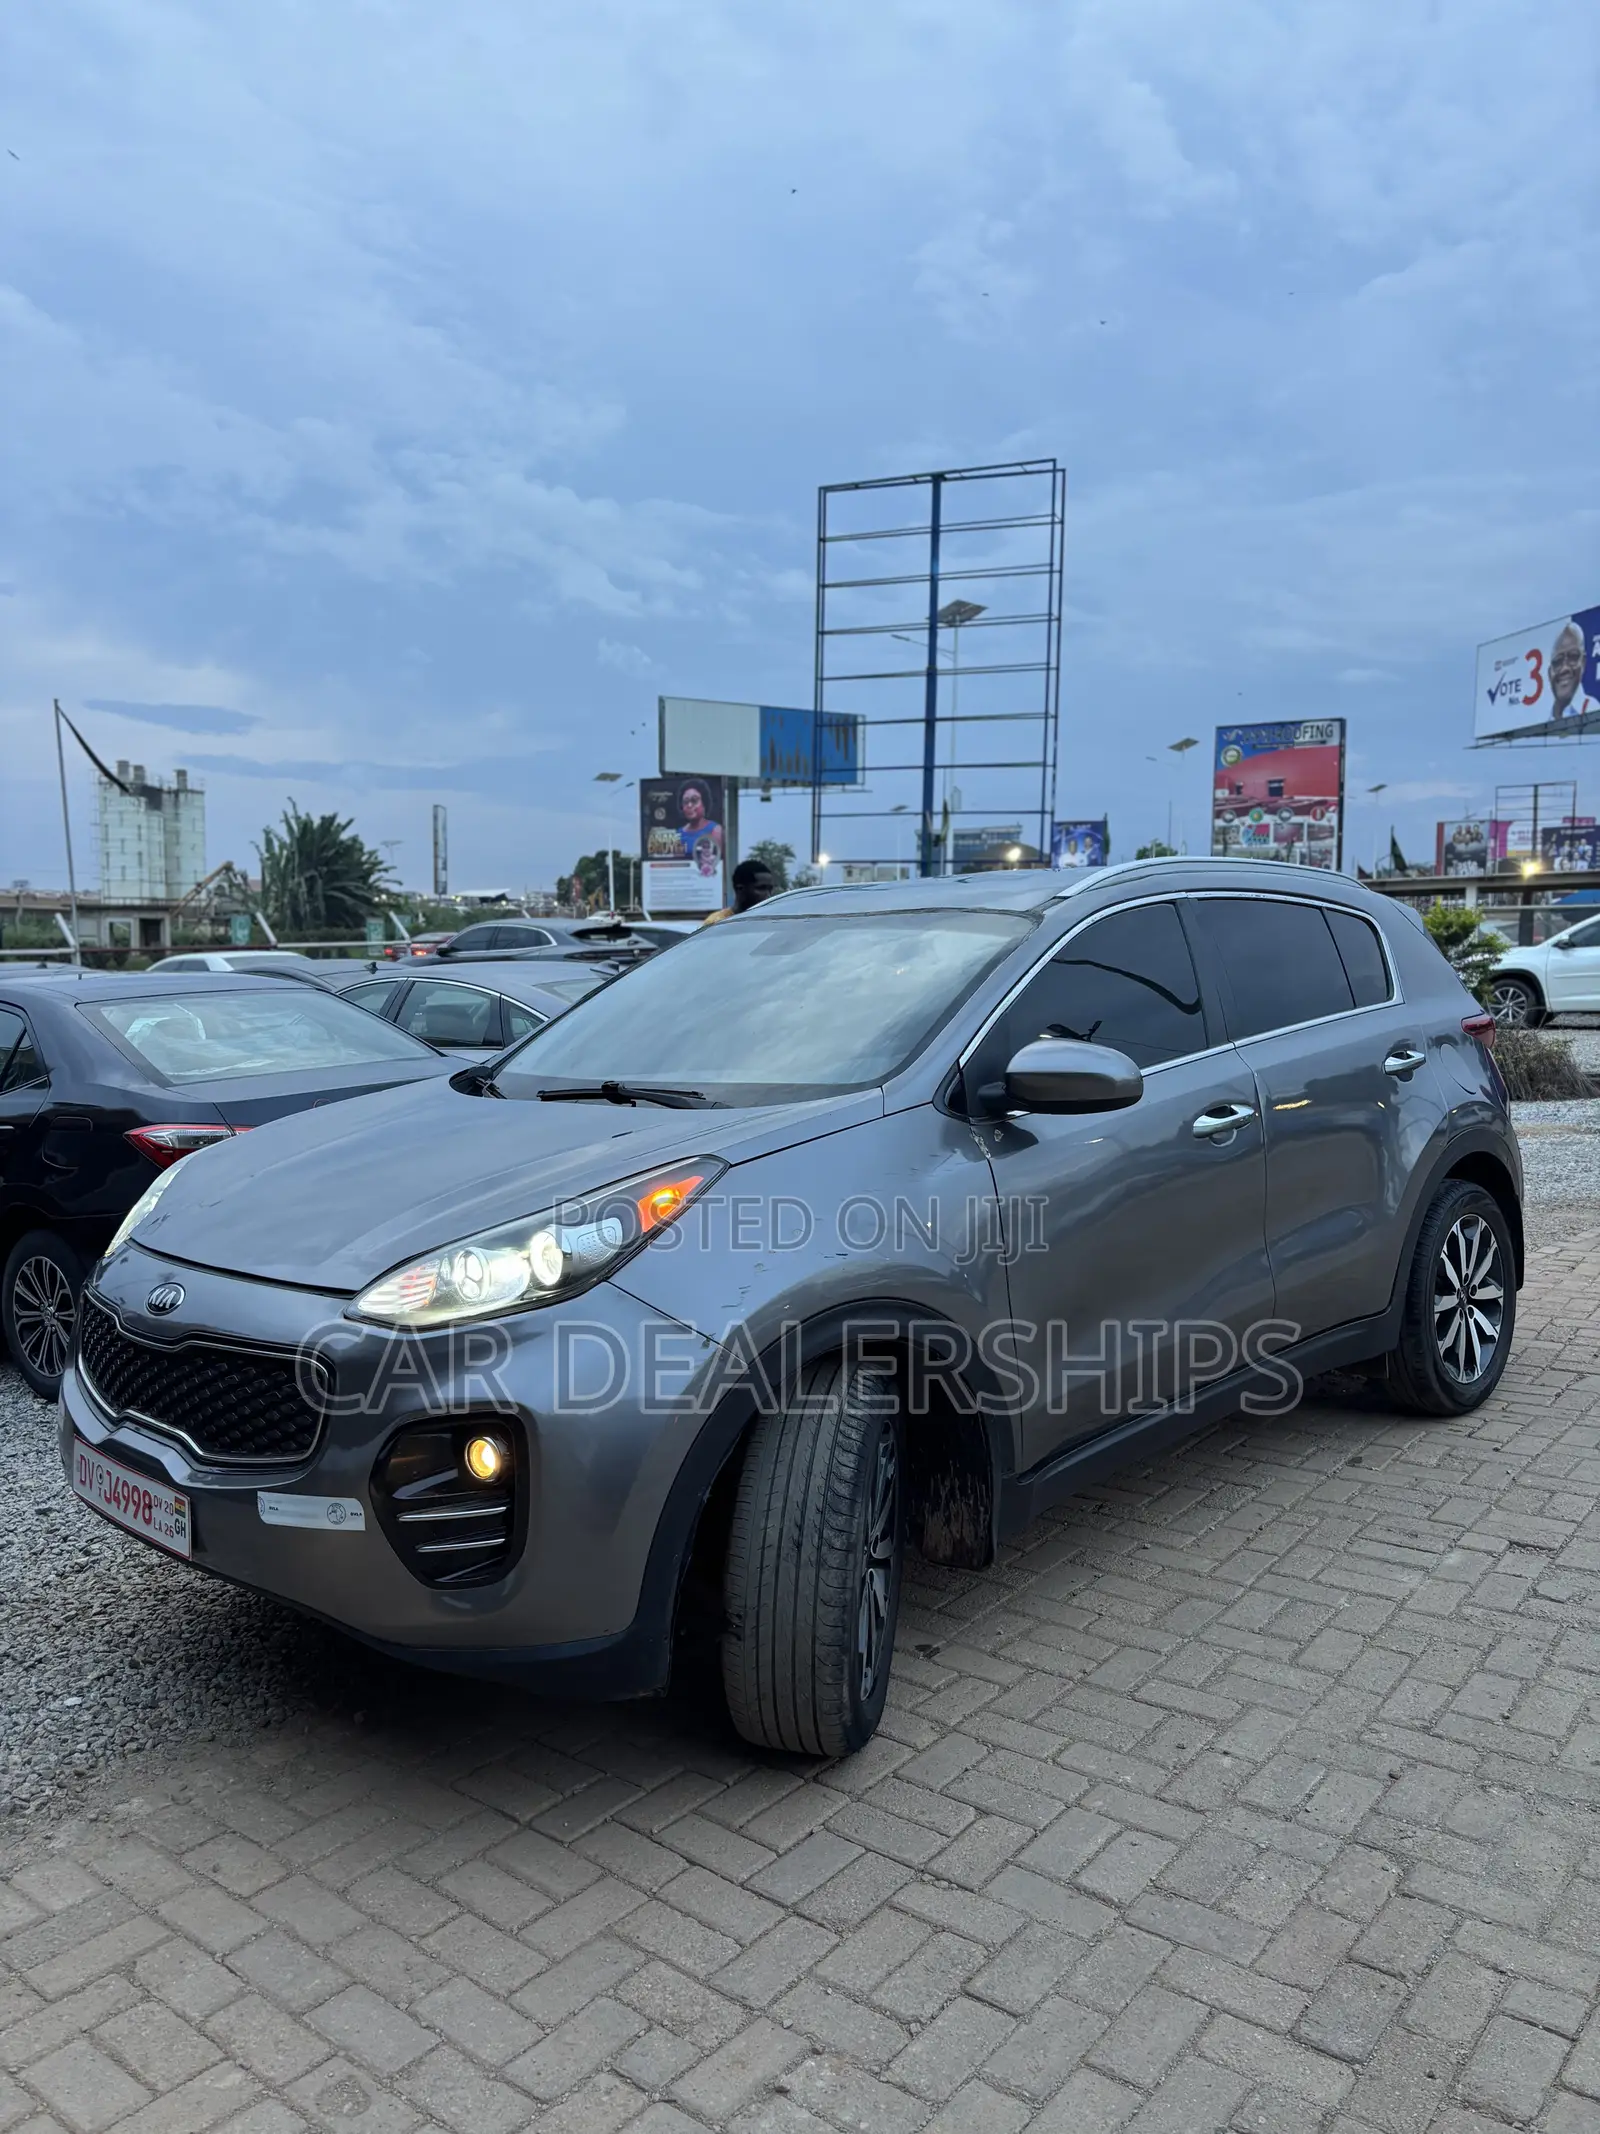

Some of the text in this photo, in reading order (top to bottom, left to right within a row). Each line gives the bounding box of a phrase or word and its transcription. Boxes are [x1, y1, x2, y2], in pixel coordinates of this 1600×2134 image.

[1522, 648, 1544, 706] 3
[148, 1287, 177, 1309] KIA
[79, 1453, 152, 1526] DV J4998
[165, 1500, 175, 1517] 20
[165, 1523, 175, 1539] 26
[175, 1518, 186, 1538] GH
